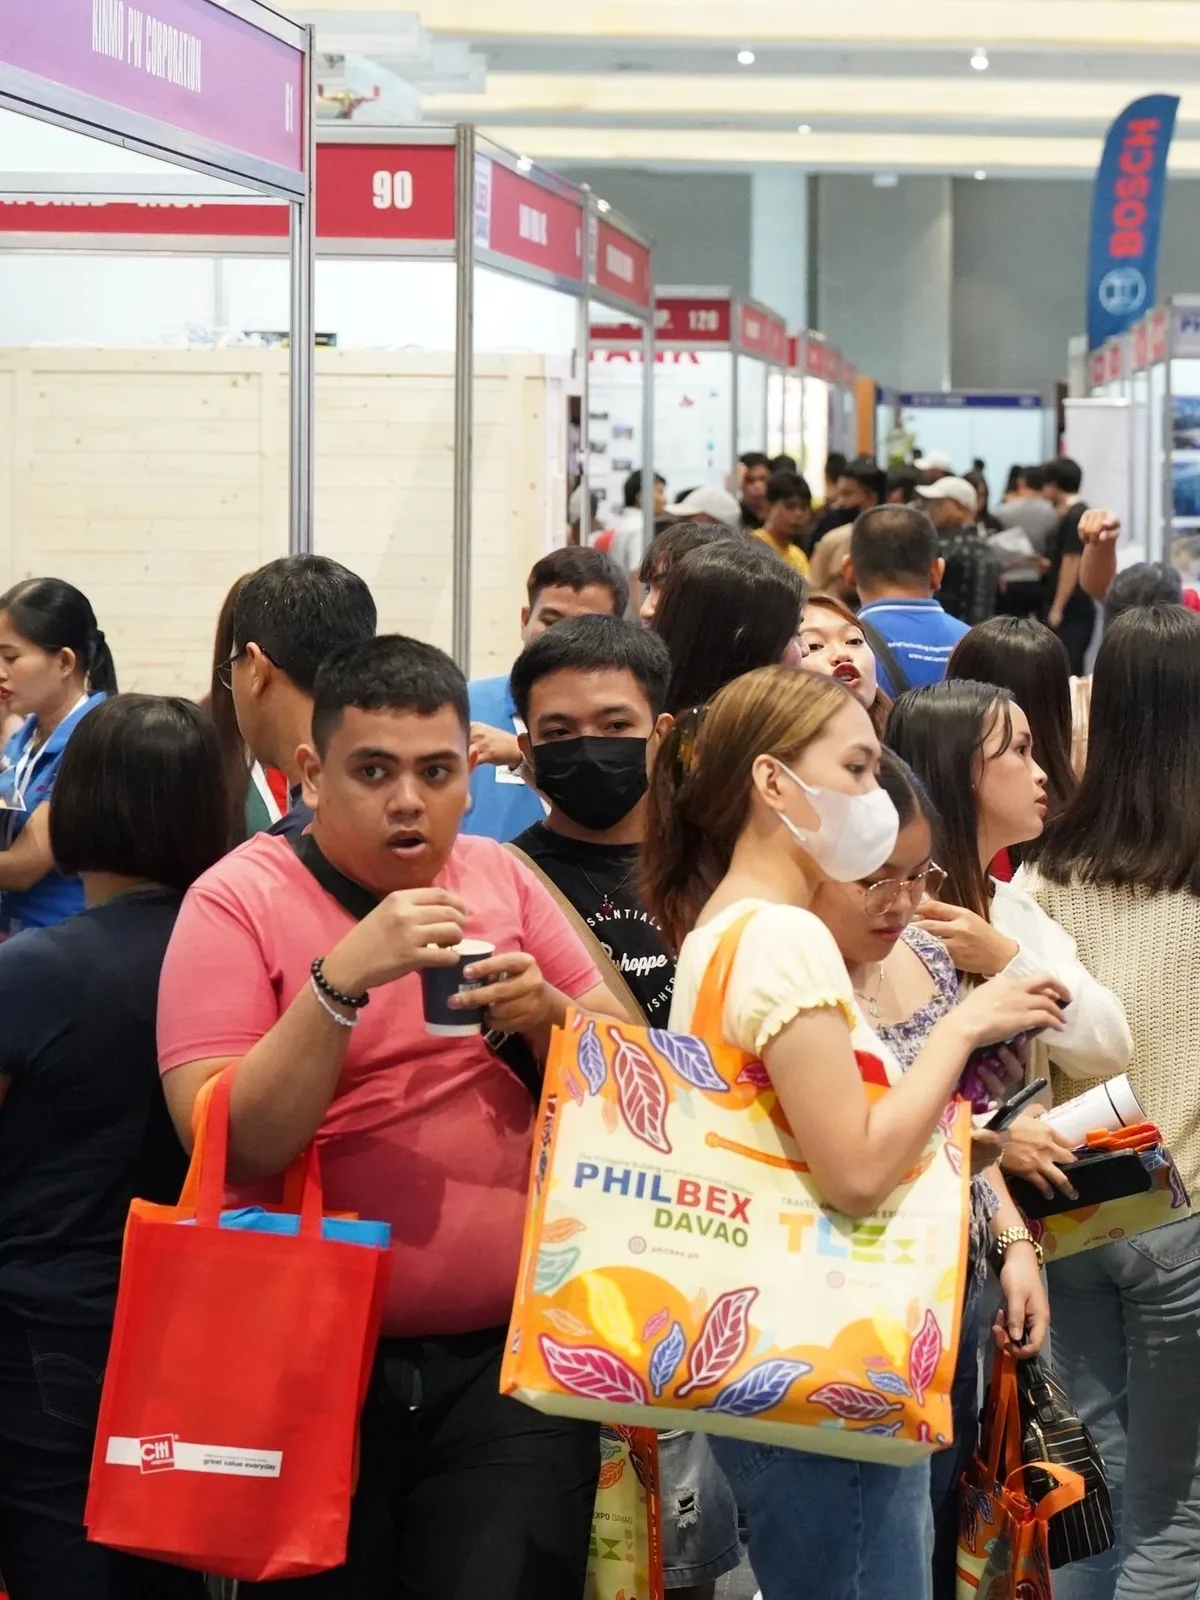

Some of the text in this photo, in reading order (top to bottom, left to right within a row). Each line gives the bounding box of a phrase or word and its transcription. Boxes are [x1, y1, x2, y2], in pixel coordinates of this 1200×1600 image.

[145, 15, 202, 93] CORPORATION
[373, 170, 413, 210] 90
[1109, 117, 1161, 259] BOSCH
[586, 909, 663, 931] SSNTIAL
[573, 1161, 753, 1225] PHILBEX
[653, 1207, 749, 1248] DAVAO
[202, 1458, 222, 1466] great
[224, 1460, 243, 1468] value
[244, 1462, 276, 1471] everyday
